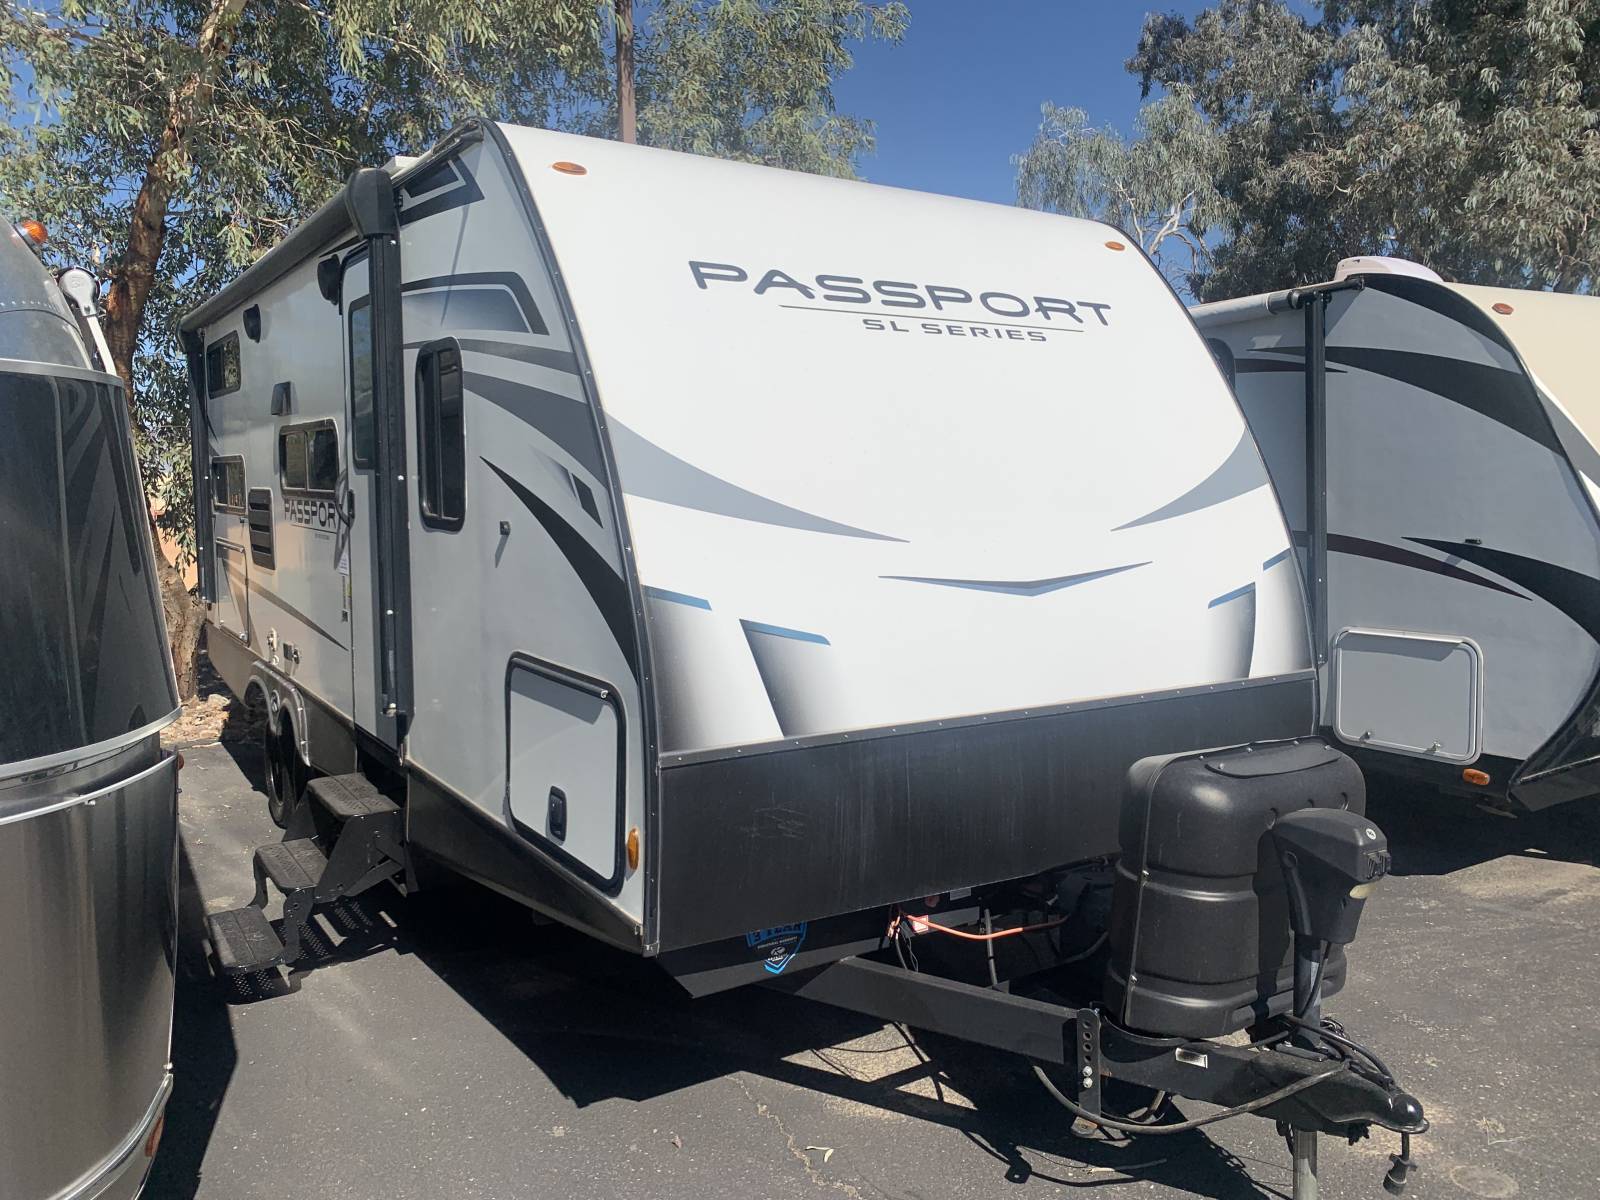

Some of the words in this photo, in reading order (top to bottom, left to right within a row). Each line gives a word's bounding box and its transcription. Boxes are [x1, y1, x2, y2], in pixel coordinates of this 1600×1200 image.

[688, 260, 1112, 327] PASSPORT
[862, 318, 910, 333] SL
[921, 322, 1047, 342] SERIES
[284, 498, 340, 529] PASSPOR
